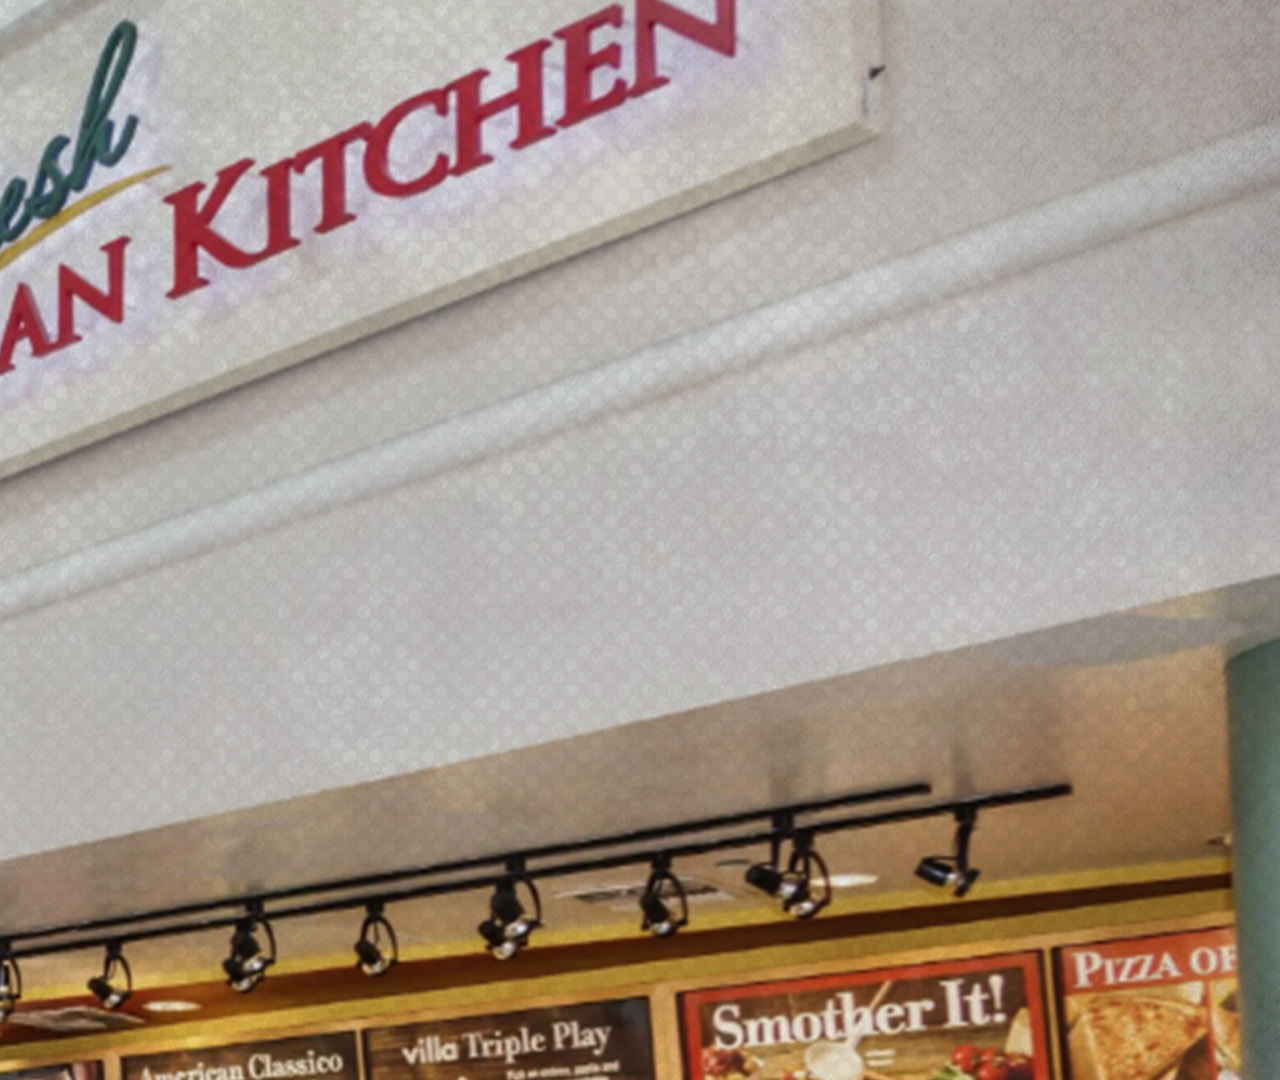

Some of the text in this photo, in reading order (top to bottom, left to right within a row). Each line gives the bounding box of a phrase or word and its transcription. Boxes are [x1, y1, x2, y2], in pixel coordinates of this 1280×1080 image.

[162, 0, 738, 300] KITCHEN
[1071, 950, 1181, 989] PIZZA
[712, 974, 1008, 1050] Smother It!
[248, 1050, 344, 1080] Classico
[402, 1021, 612, 1065] villa Triple Play
